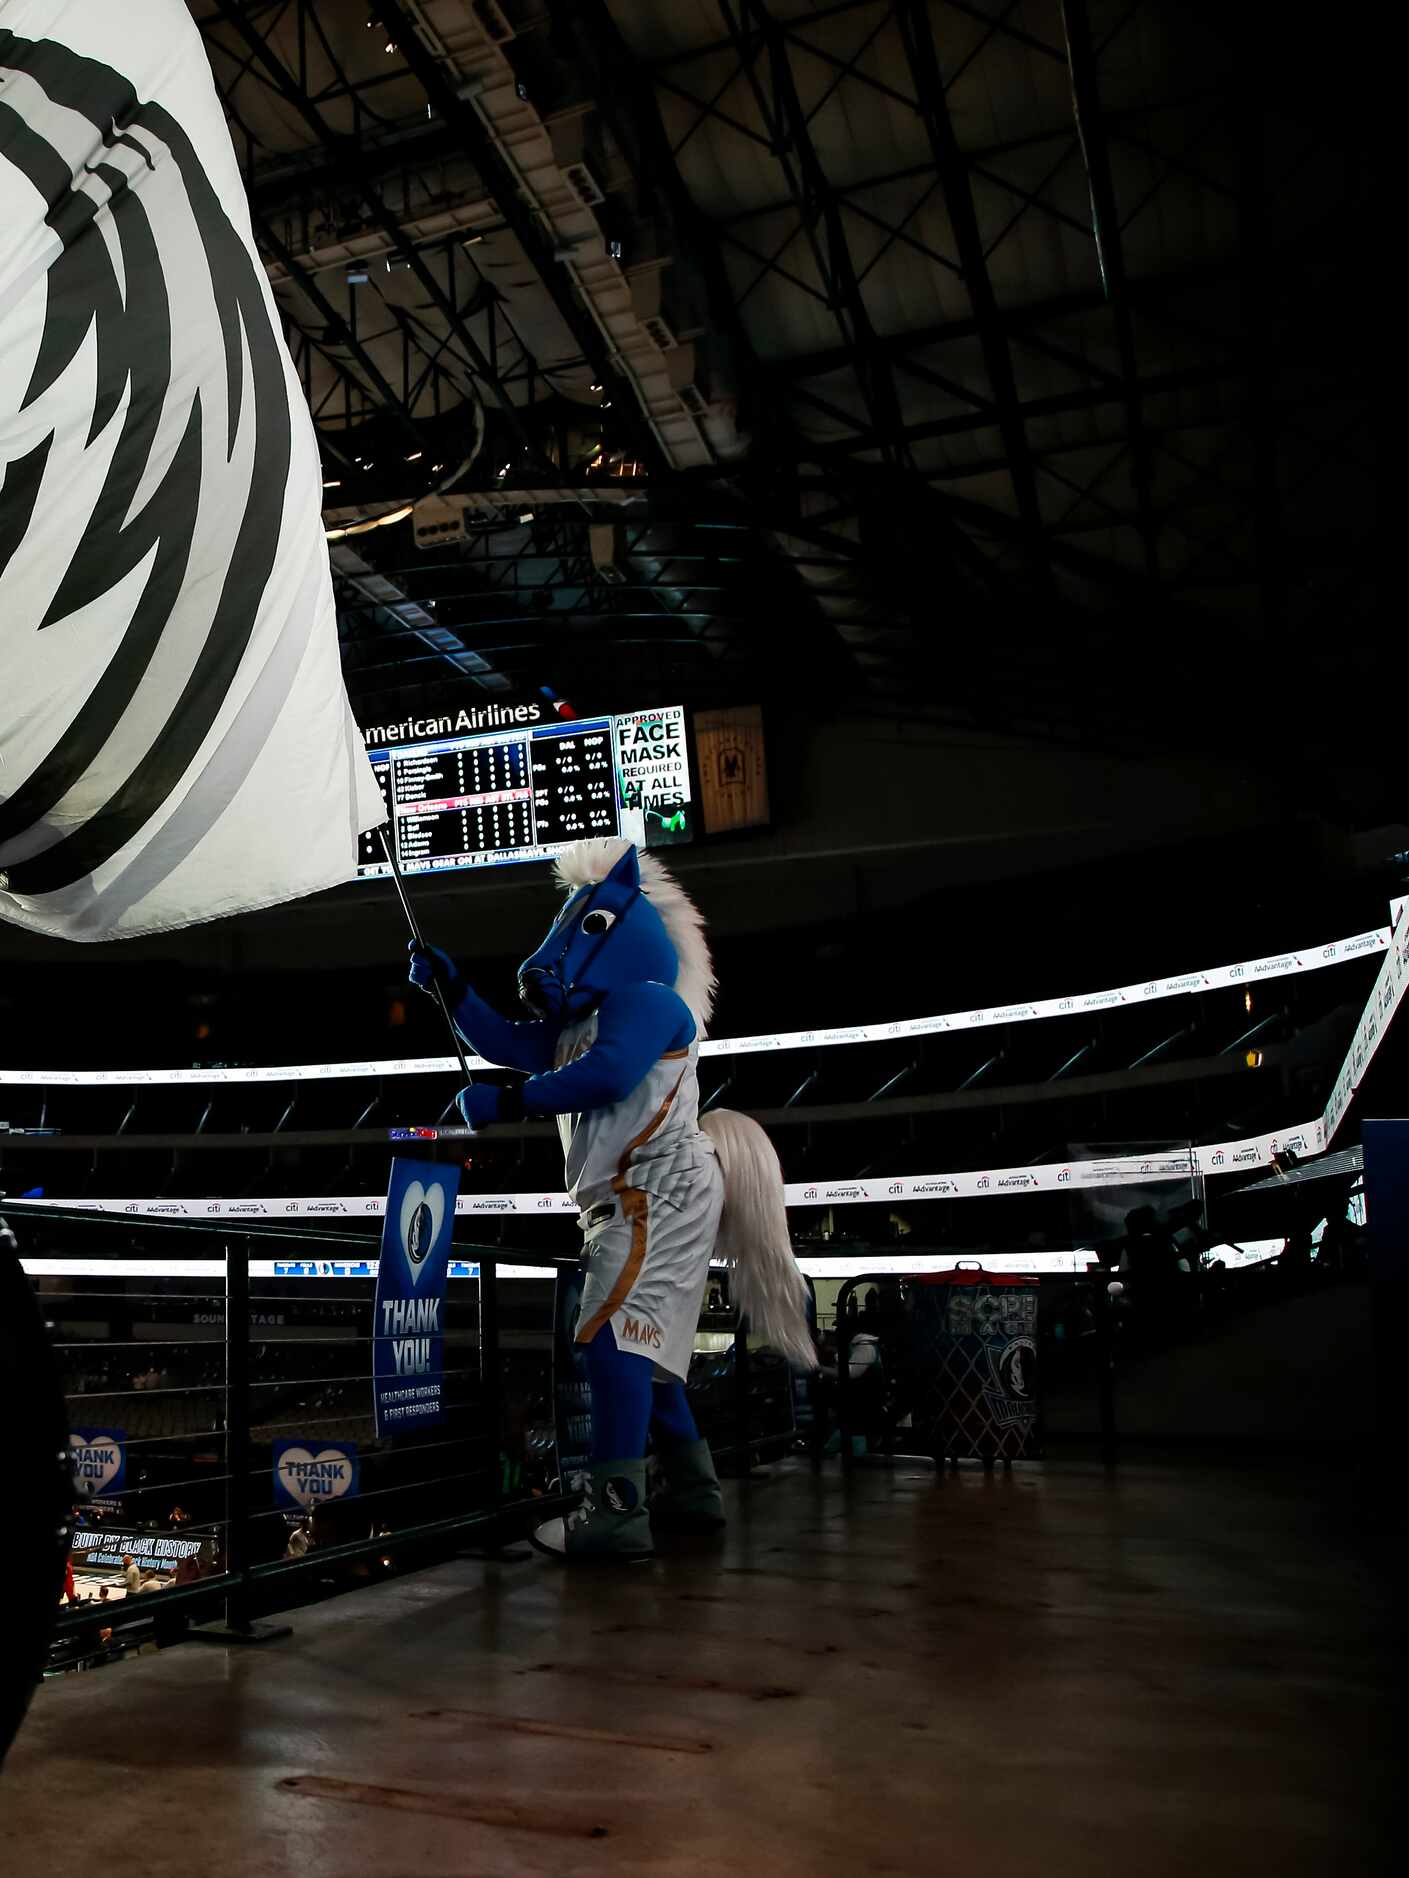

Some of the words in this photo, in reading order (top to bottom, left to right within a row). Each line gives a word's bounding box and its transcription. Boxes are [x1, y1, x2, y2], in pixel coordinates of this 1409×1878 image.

[365, 717, 452, 744] merican
[455, 703, 540, 731] Airlines
[616, 710, 681, 728] APPROVED
[619, 722, 680, 746] FACE
[559, 740, 576, 750] DAL
[584, 736, 603, 746] NOP
[621, 743, 681, 765] MASK
[622, 761, 682, 778] REQUIRED
[625, 780, 646, 794] AT
[651, 776, 682, 790] ALL
[624, 791, 684, 810] TIMES
[1323, 944, 1336, 960] citi
[1230, 964, 1244, 978] citi
[977, 1176, 990, 1188] citi
[1058, 1168, 1072, 1182] citi
[804, 1186, 818, 1200] citi
[888, 1182, 904, 1194] citi
[538, 1198, 552, 1208] citi
[191, 1312, 224, 1324] SOUN
[250, 1313, 286, 1325] TAGE
[382, 1298, 440, 1336] THANK
[622, 1319, 664, 1351] MAVS
[392, 1338, 430, 1375] YOU!
[380, 1388, 415, 1403] HEALTHCARE
[416, 1385, 440, 1398] WORKERS
[406, 1401, 440, 1417] RESPONDERS
[286, 1462, 345, 1480] THANK
[297, 1478, 332, 1495] YOU
[71, 1532, 104, 1549] BUILT
[102, 1535, 120, 1552] BY
[119, 1536, 154, 1556] BLACK
[154, 1539, 202, 1559] HISTORY
